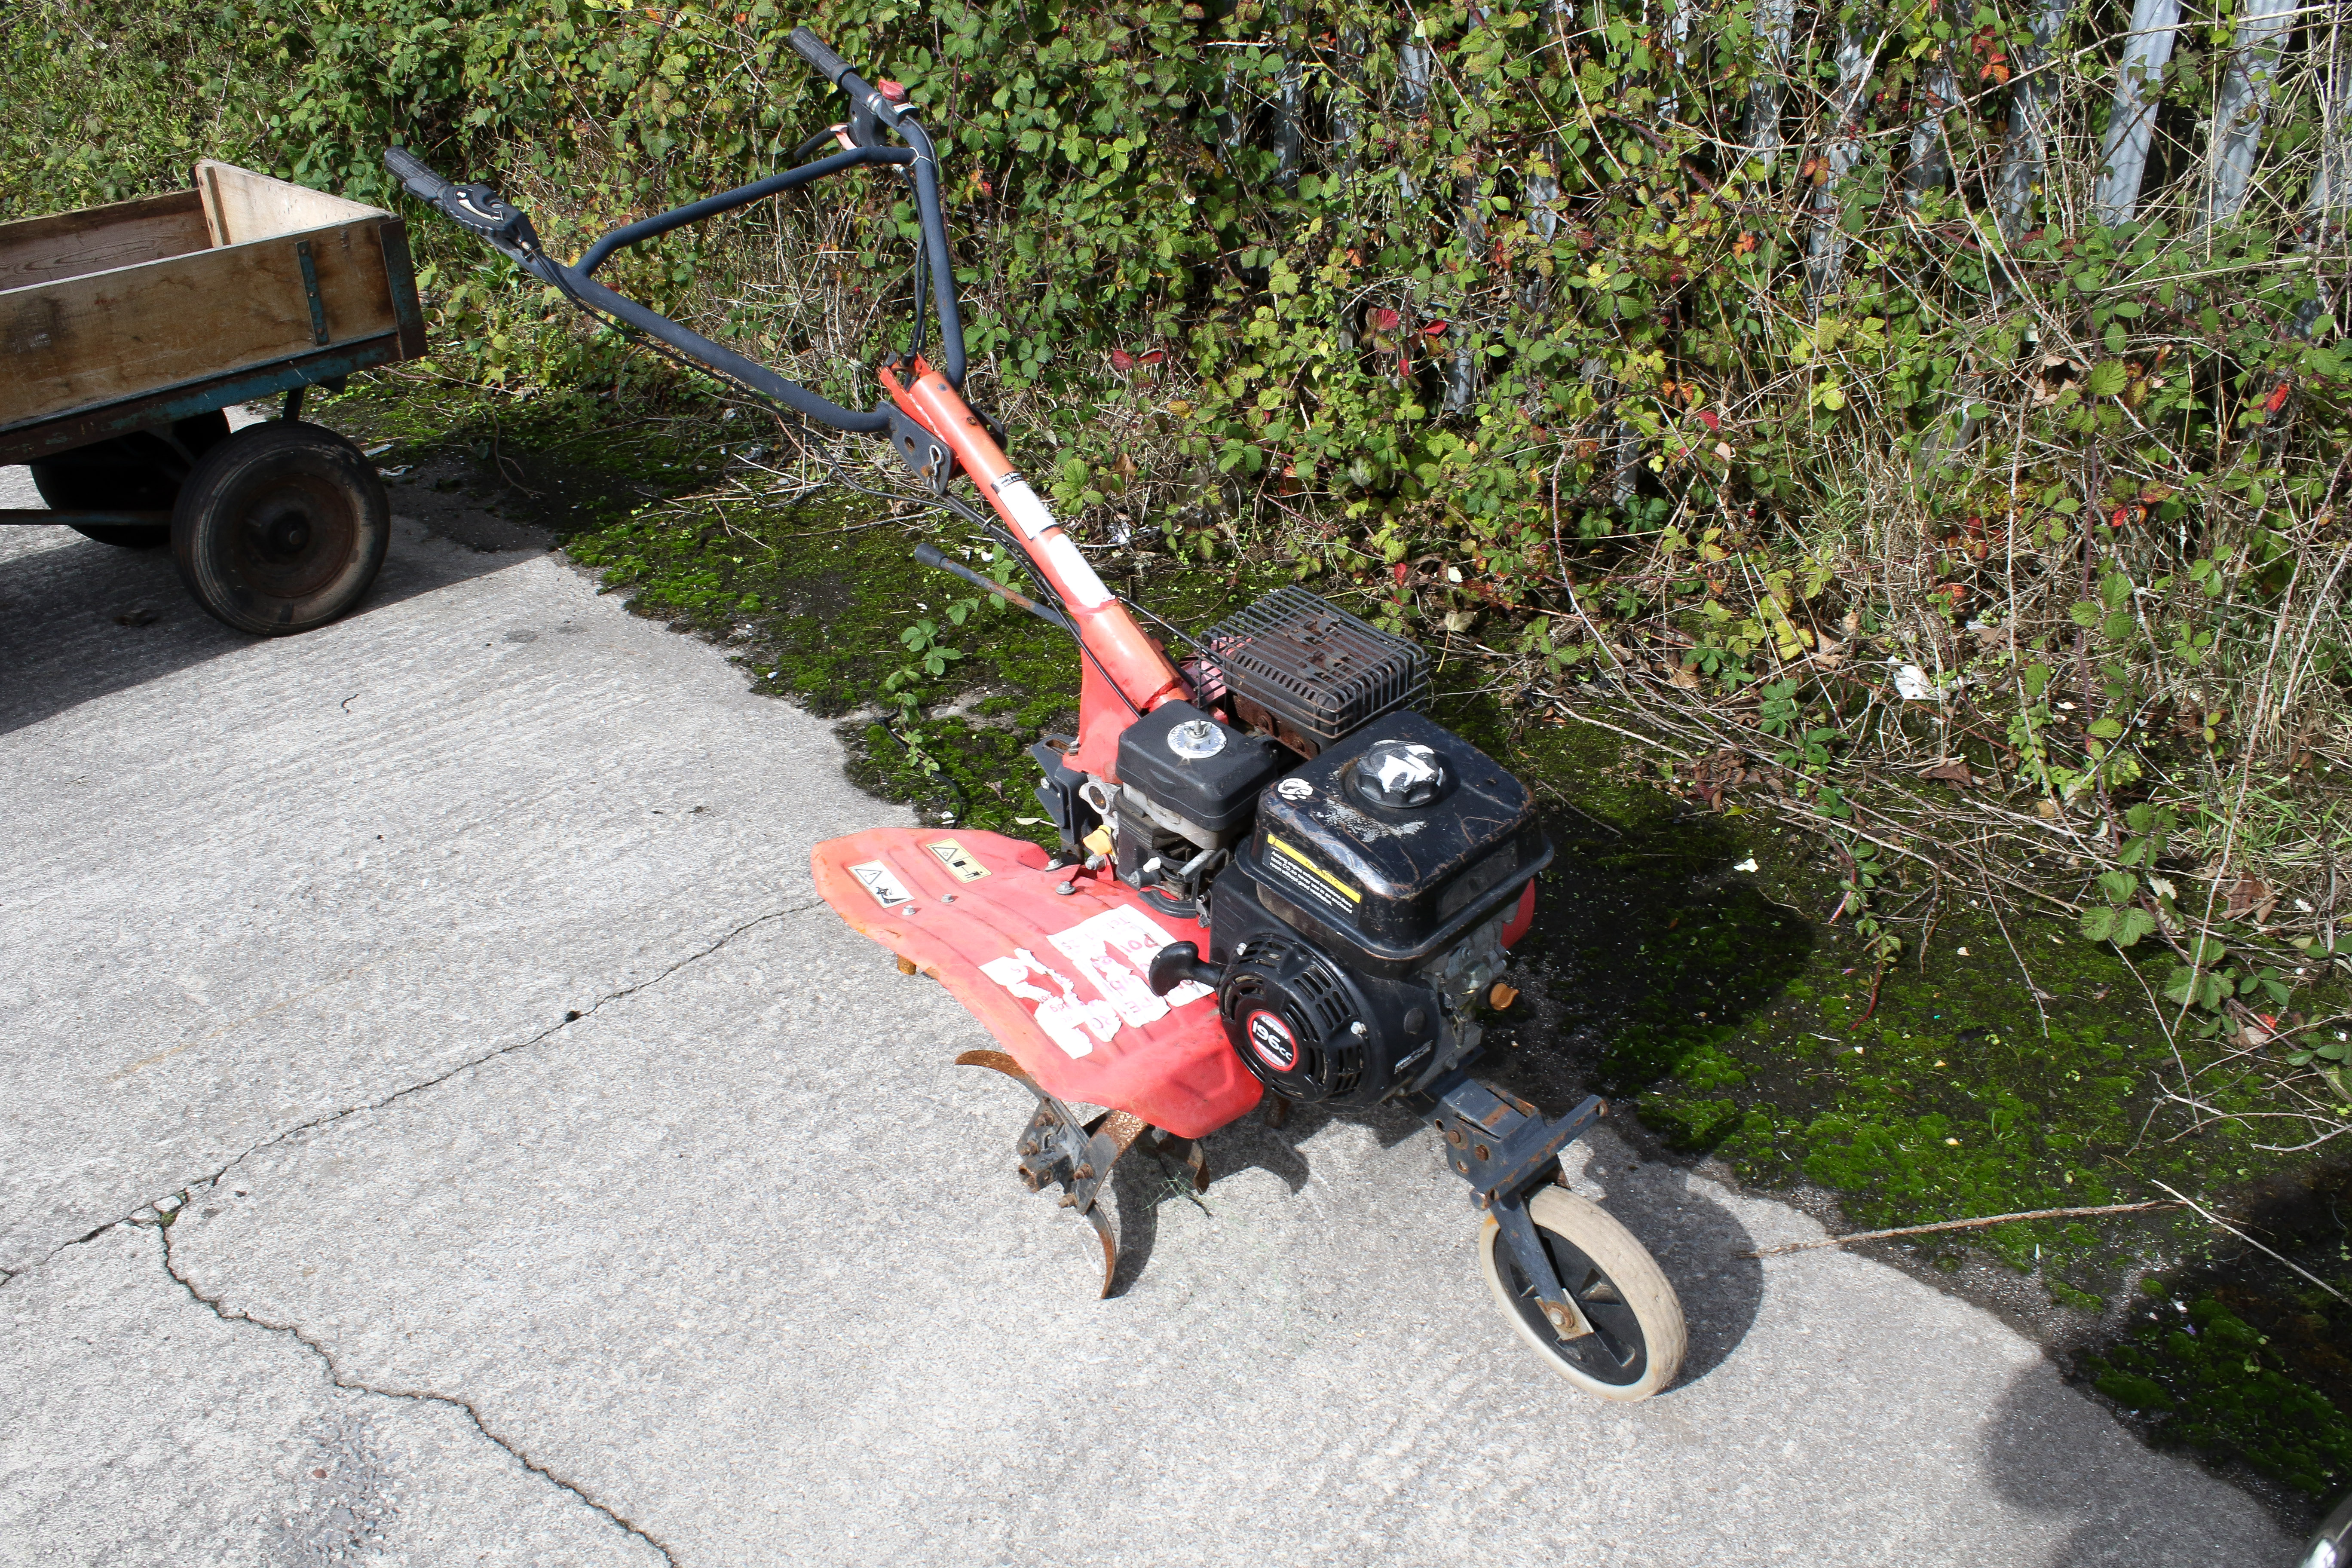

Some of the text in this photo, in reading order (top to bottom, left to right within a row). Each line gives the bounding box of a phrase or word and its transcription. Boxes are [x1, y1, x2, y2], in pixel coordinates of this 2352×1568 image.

[1271, 851, 1288, 864] Among
[1305, 861, 1339, 886] WARNING
[1253, 1020, 1292, 1060] 196cc
